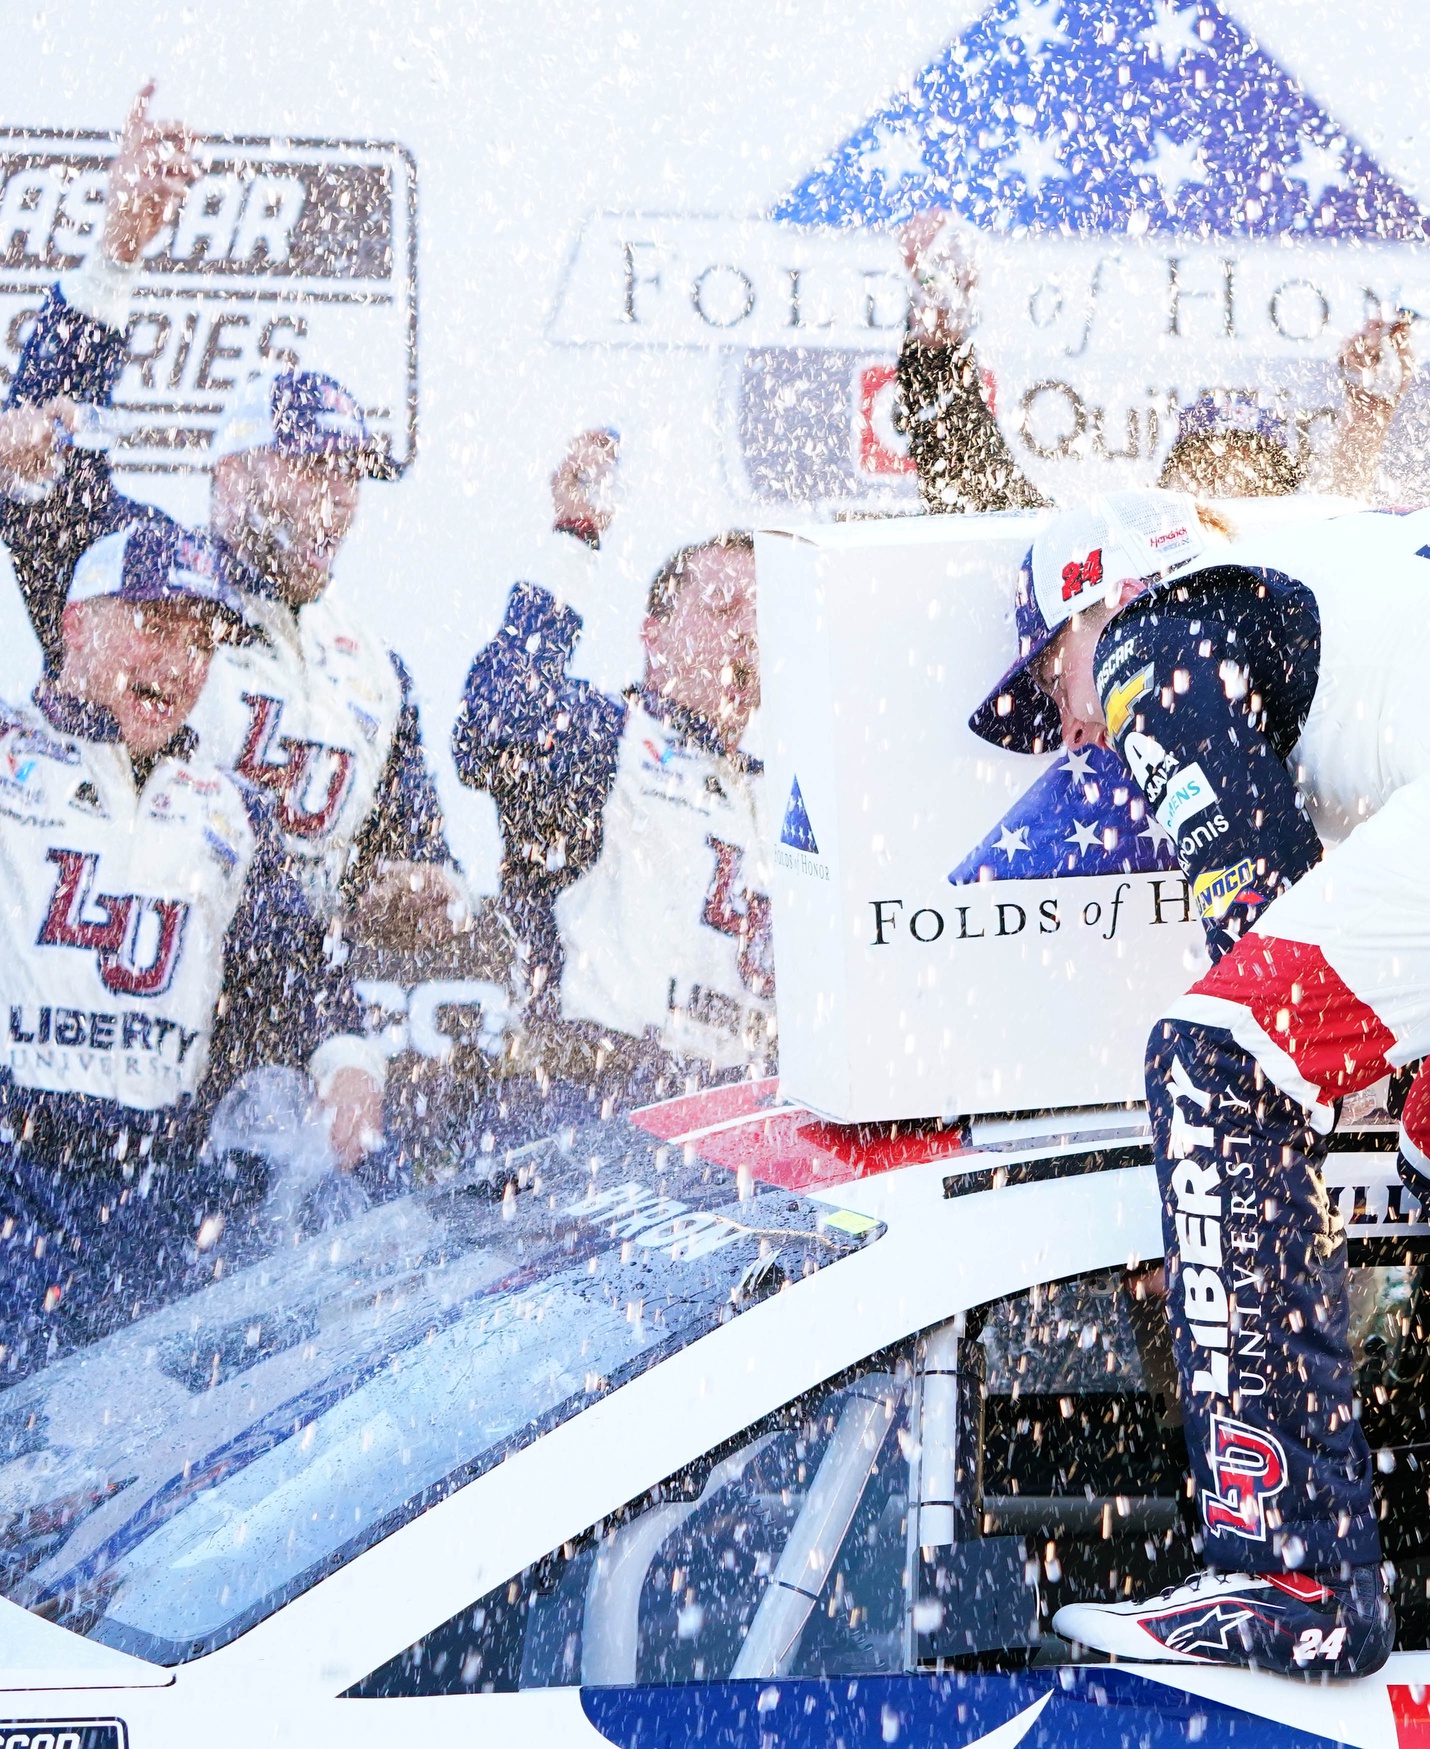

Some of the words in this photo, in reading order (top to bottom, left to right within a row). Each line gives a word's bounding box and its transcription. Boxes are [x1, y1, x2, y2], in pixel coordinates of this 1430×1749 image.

[614, 242, 912, 330] FOLD
[1029, 256, 1118, 357] of
[1061, 548, 1103, 601] 24
[1096, 638, 1135, 697] ASCAR
[36, 847, 191, 998] LU
[869, 897, 1062, 946] FOLDS
[1083, 882, 1131, 940] of
[9, 1005, 199, 1063] LIBERTY
[1166, 1054, 1230, 1397] LIBERTY
[1293, 1627, 1348, 1660] 24
